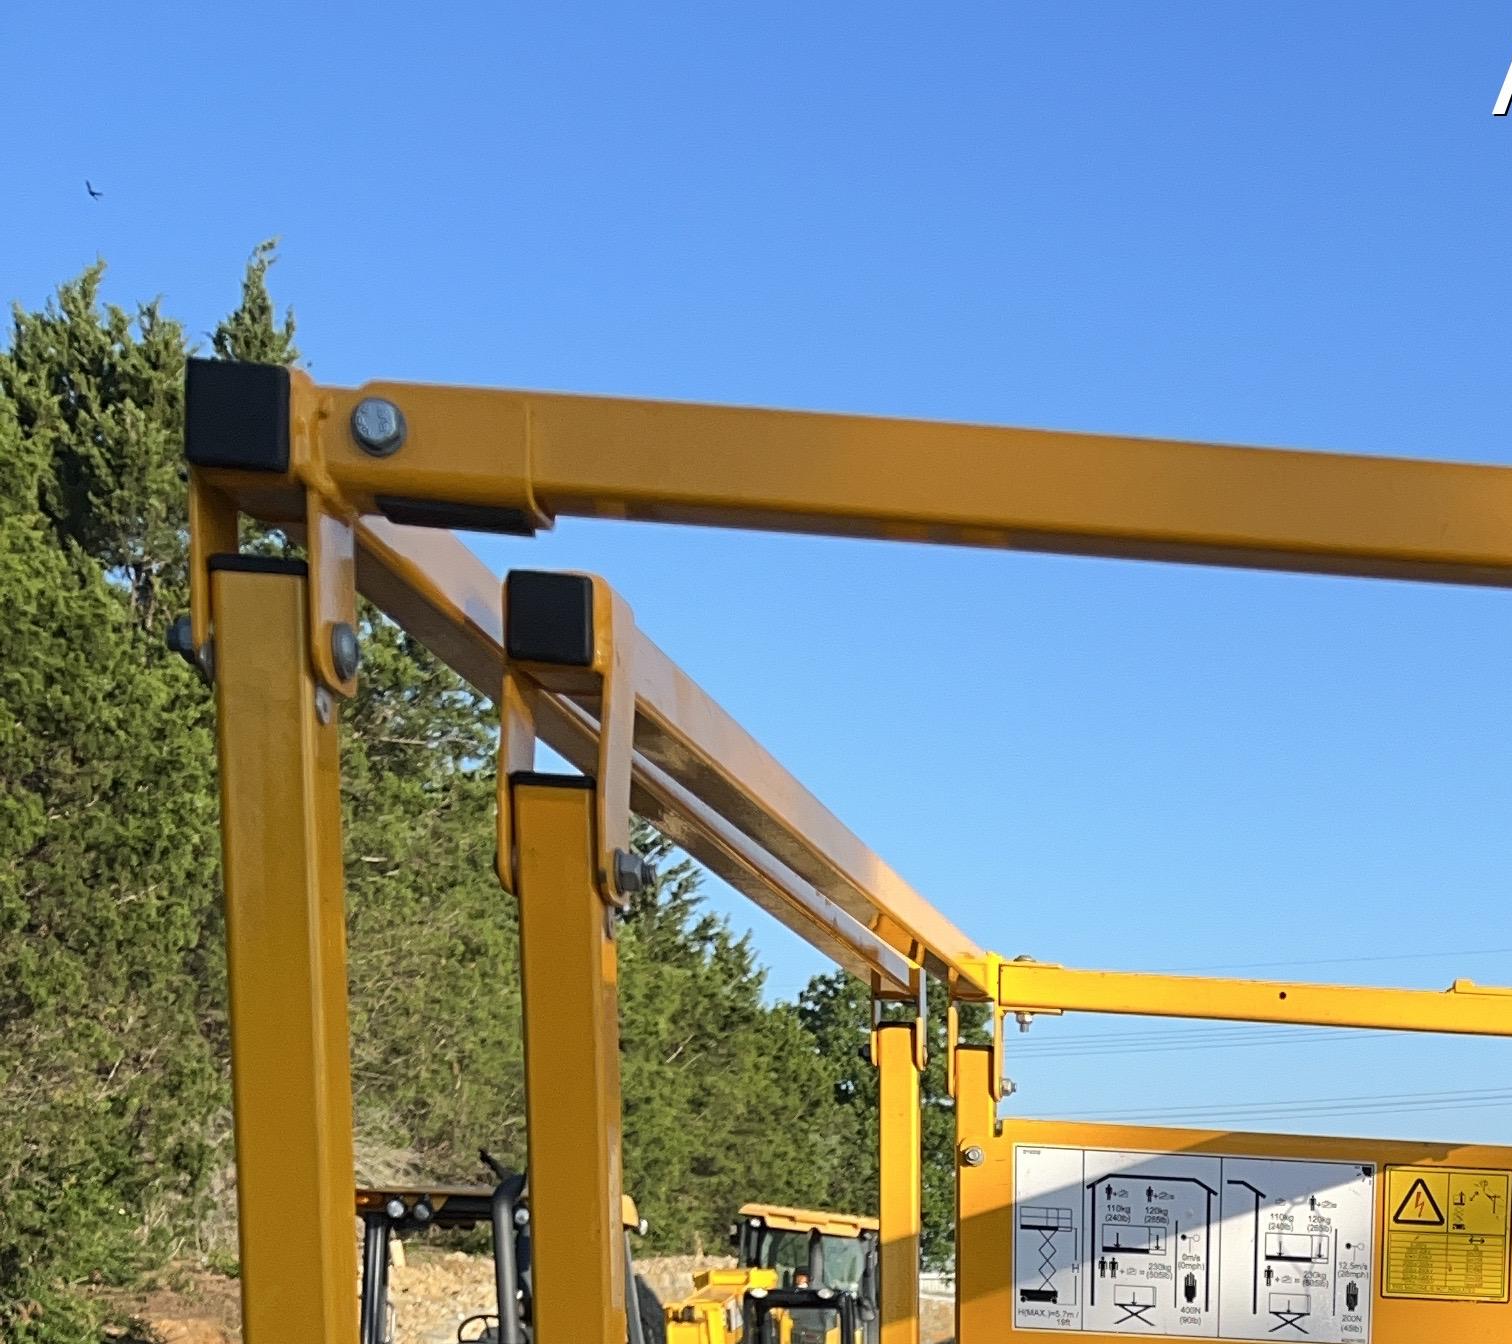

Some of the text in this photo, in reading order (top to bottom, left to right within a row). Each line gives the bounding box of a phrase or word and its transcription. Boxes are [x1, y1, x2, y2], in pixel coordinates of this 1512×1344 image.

[1107, 1204, 1131, 1215] 110kg
[1145, 1206, 1169, 1217] 120kg
[1105, 1213, 1131, 1223] (240lb)
[1270, 1213, 1294, 1223] 110kg
[1308, 1215, 1331, 1225] 120kg
[1072, 1263, 1080, 1273] H
[1148, 1263, 1173, 1272] 230kg
[1178, 1261, 1205, 1271] (0mph)
